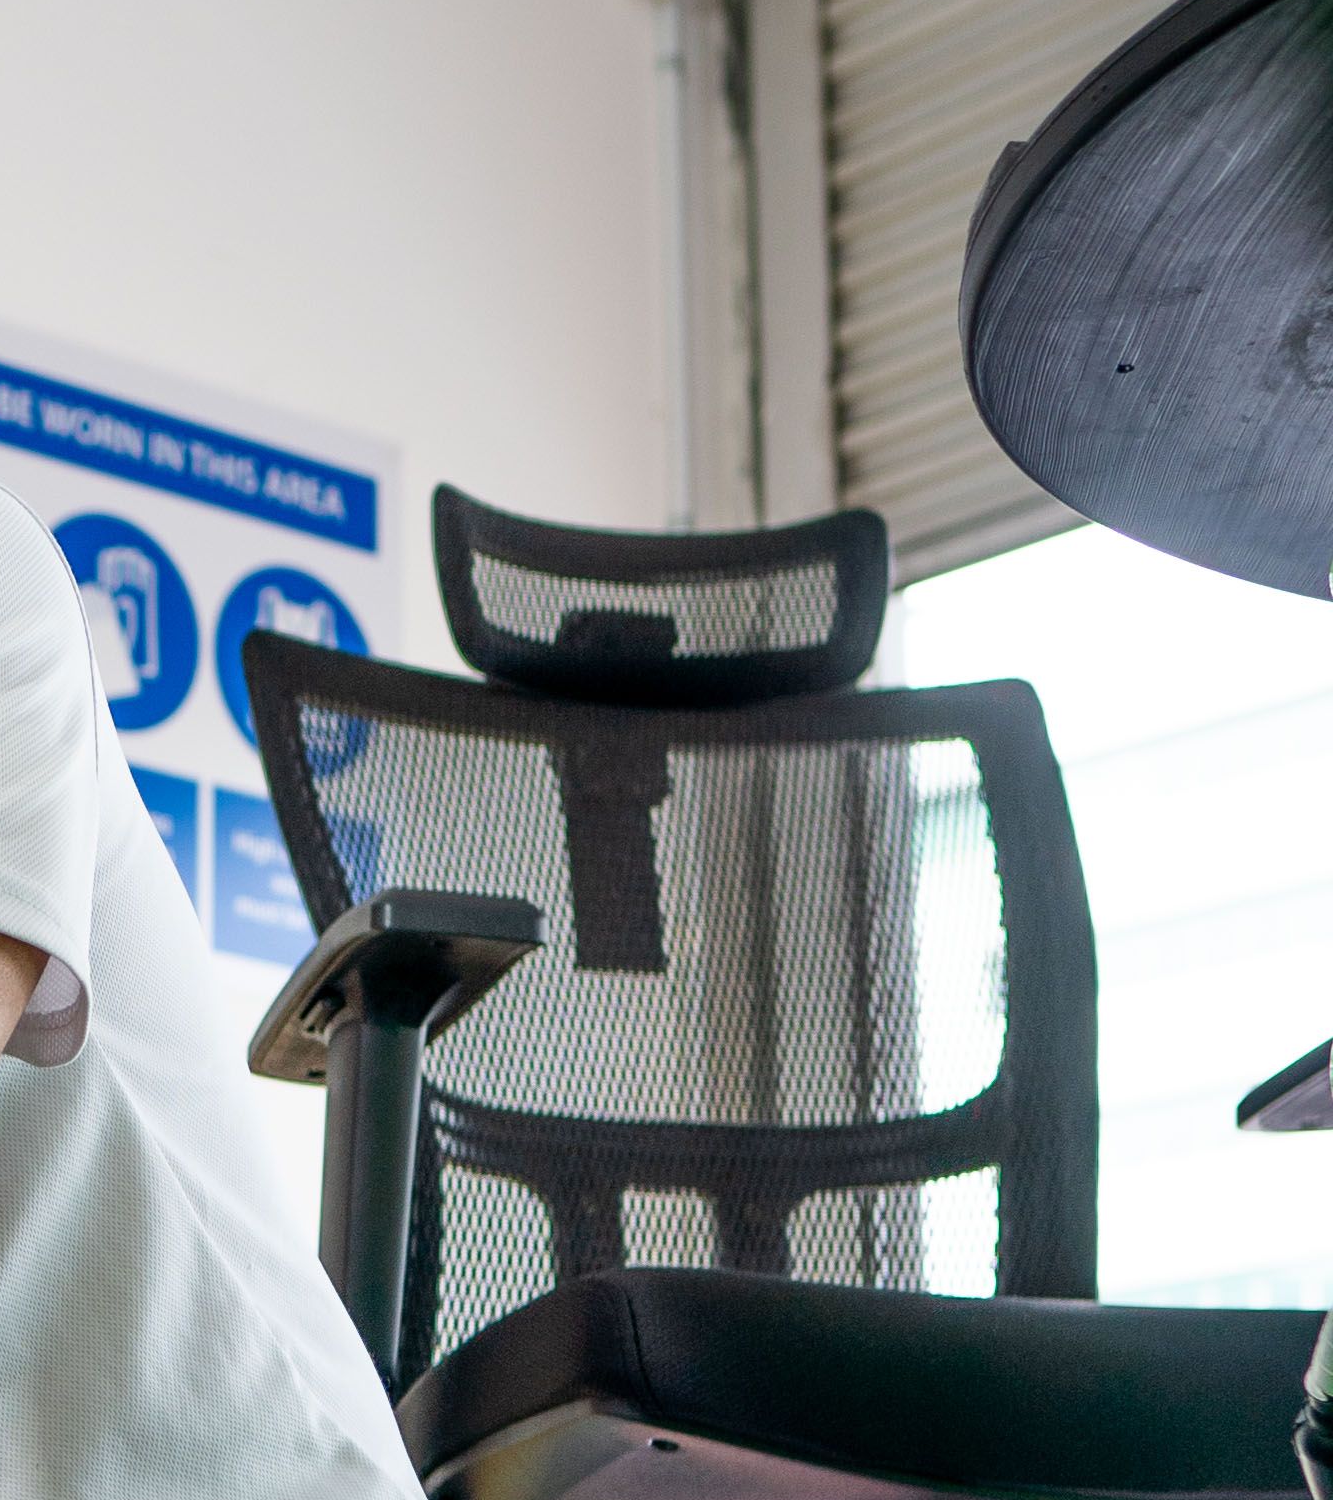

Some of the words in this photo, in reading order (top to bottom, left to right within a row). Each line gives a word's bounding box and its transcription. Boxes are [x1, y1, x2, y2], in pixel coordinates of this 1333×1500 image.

[39, 396, 145, 461] WORN
[148, 428, 188, 475] IN
[188, 440, 261, 496] THIS
[262, 464, 349, 522] AREA
